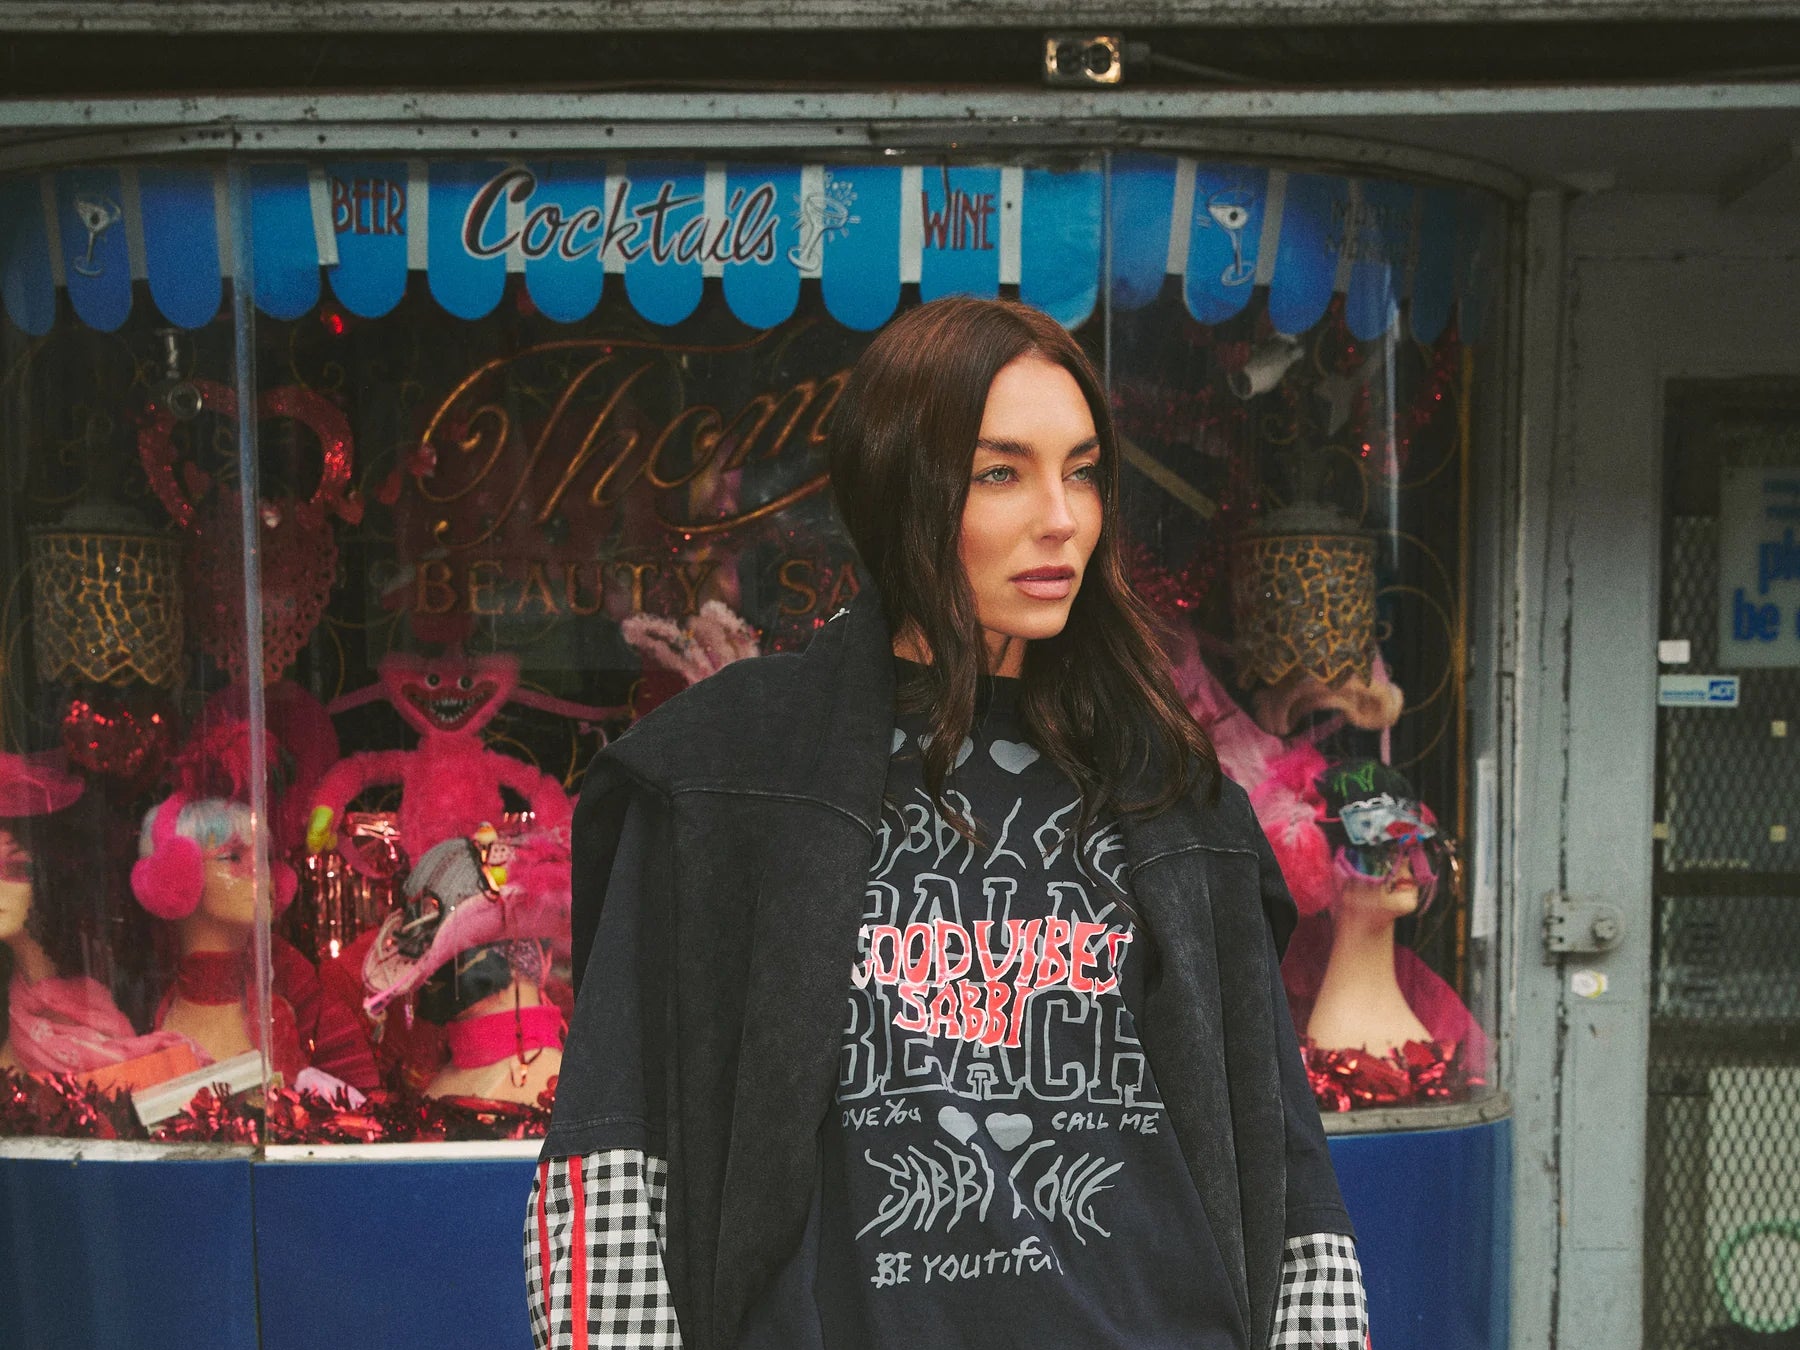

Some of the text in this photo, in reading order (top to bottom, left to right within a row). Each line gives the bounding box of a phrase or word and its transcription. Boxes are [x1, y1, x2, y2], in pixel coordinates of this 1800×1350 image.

[331, 178, 406, 236] BEER
[463, 168, 778, 265] Cocktails
[922, 190, 995, 251] WINE
[414, 559, 714, 615] BEAUTY
[892, 978, 1034, 1049] SABBI
[1051, 1111, 1160, 1135] CALL ME
[855, 1139, 1125, 1246] SABBI LOVE
[871, 1252, 912, 1289] BE
